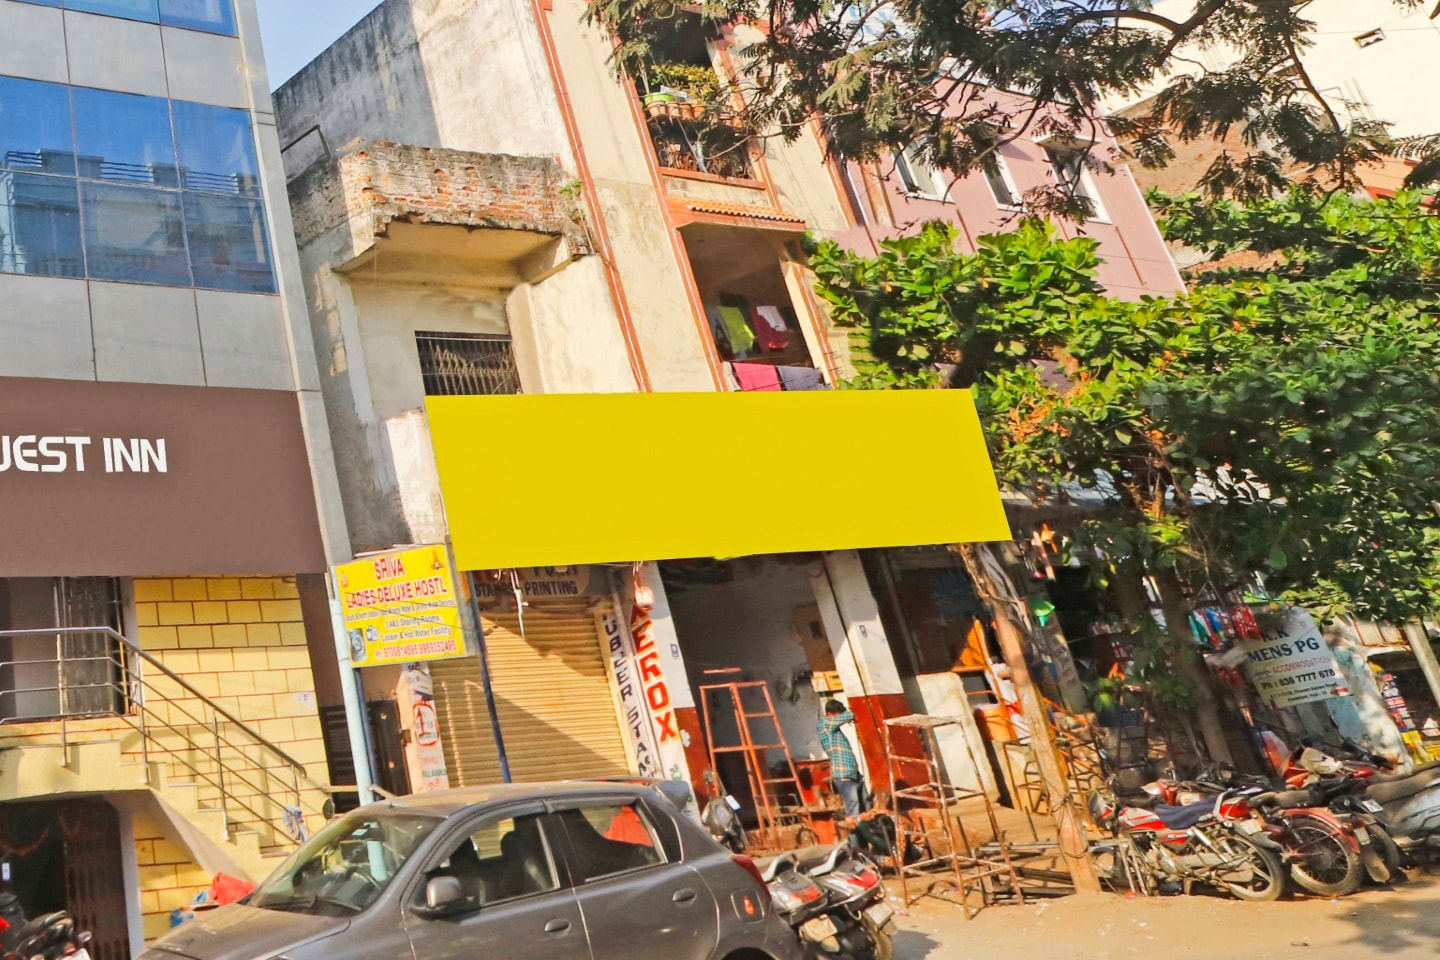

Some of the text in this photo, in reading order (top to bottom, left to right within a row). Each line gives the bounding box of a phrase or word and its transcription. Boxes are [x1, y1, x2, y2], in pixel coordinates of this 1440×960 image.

[103, 437, 167, 472] INN
[346, 577, 447, 608] LADIES DELUXE HOSTL
[524, 581, 578, 596] PRINTING
[415, 629, 430, 637] Water
[431, 625, 451, 635] Facility
[1247, 637, 1320, 663] MENS PG
[1296, 672, 1317, 683] 7777
[1319, 669, 1335, 678] 678
